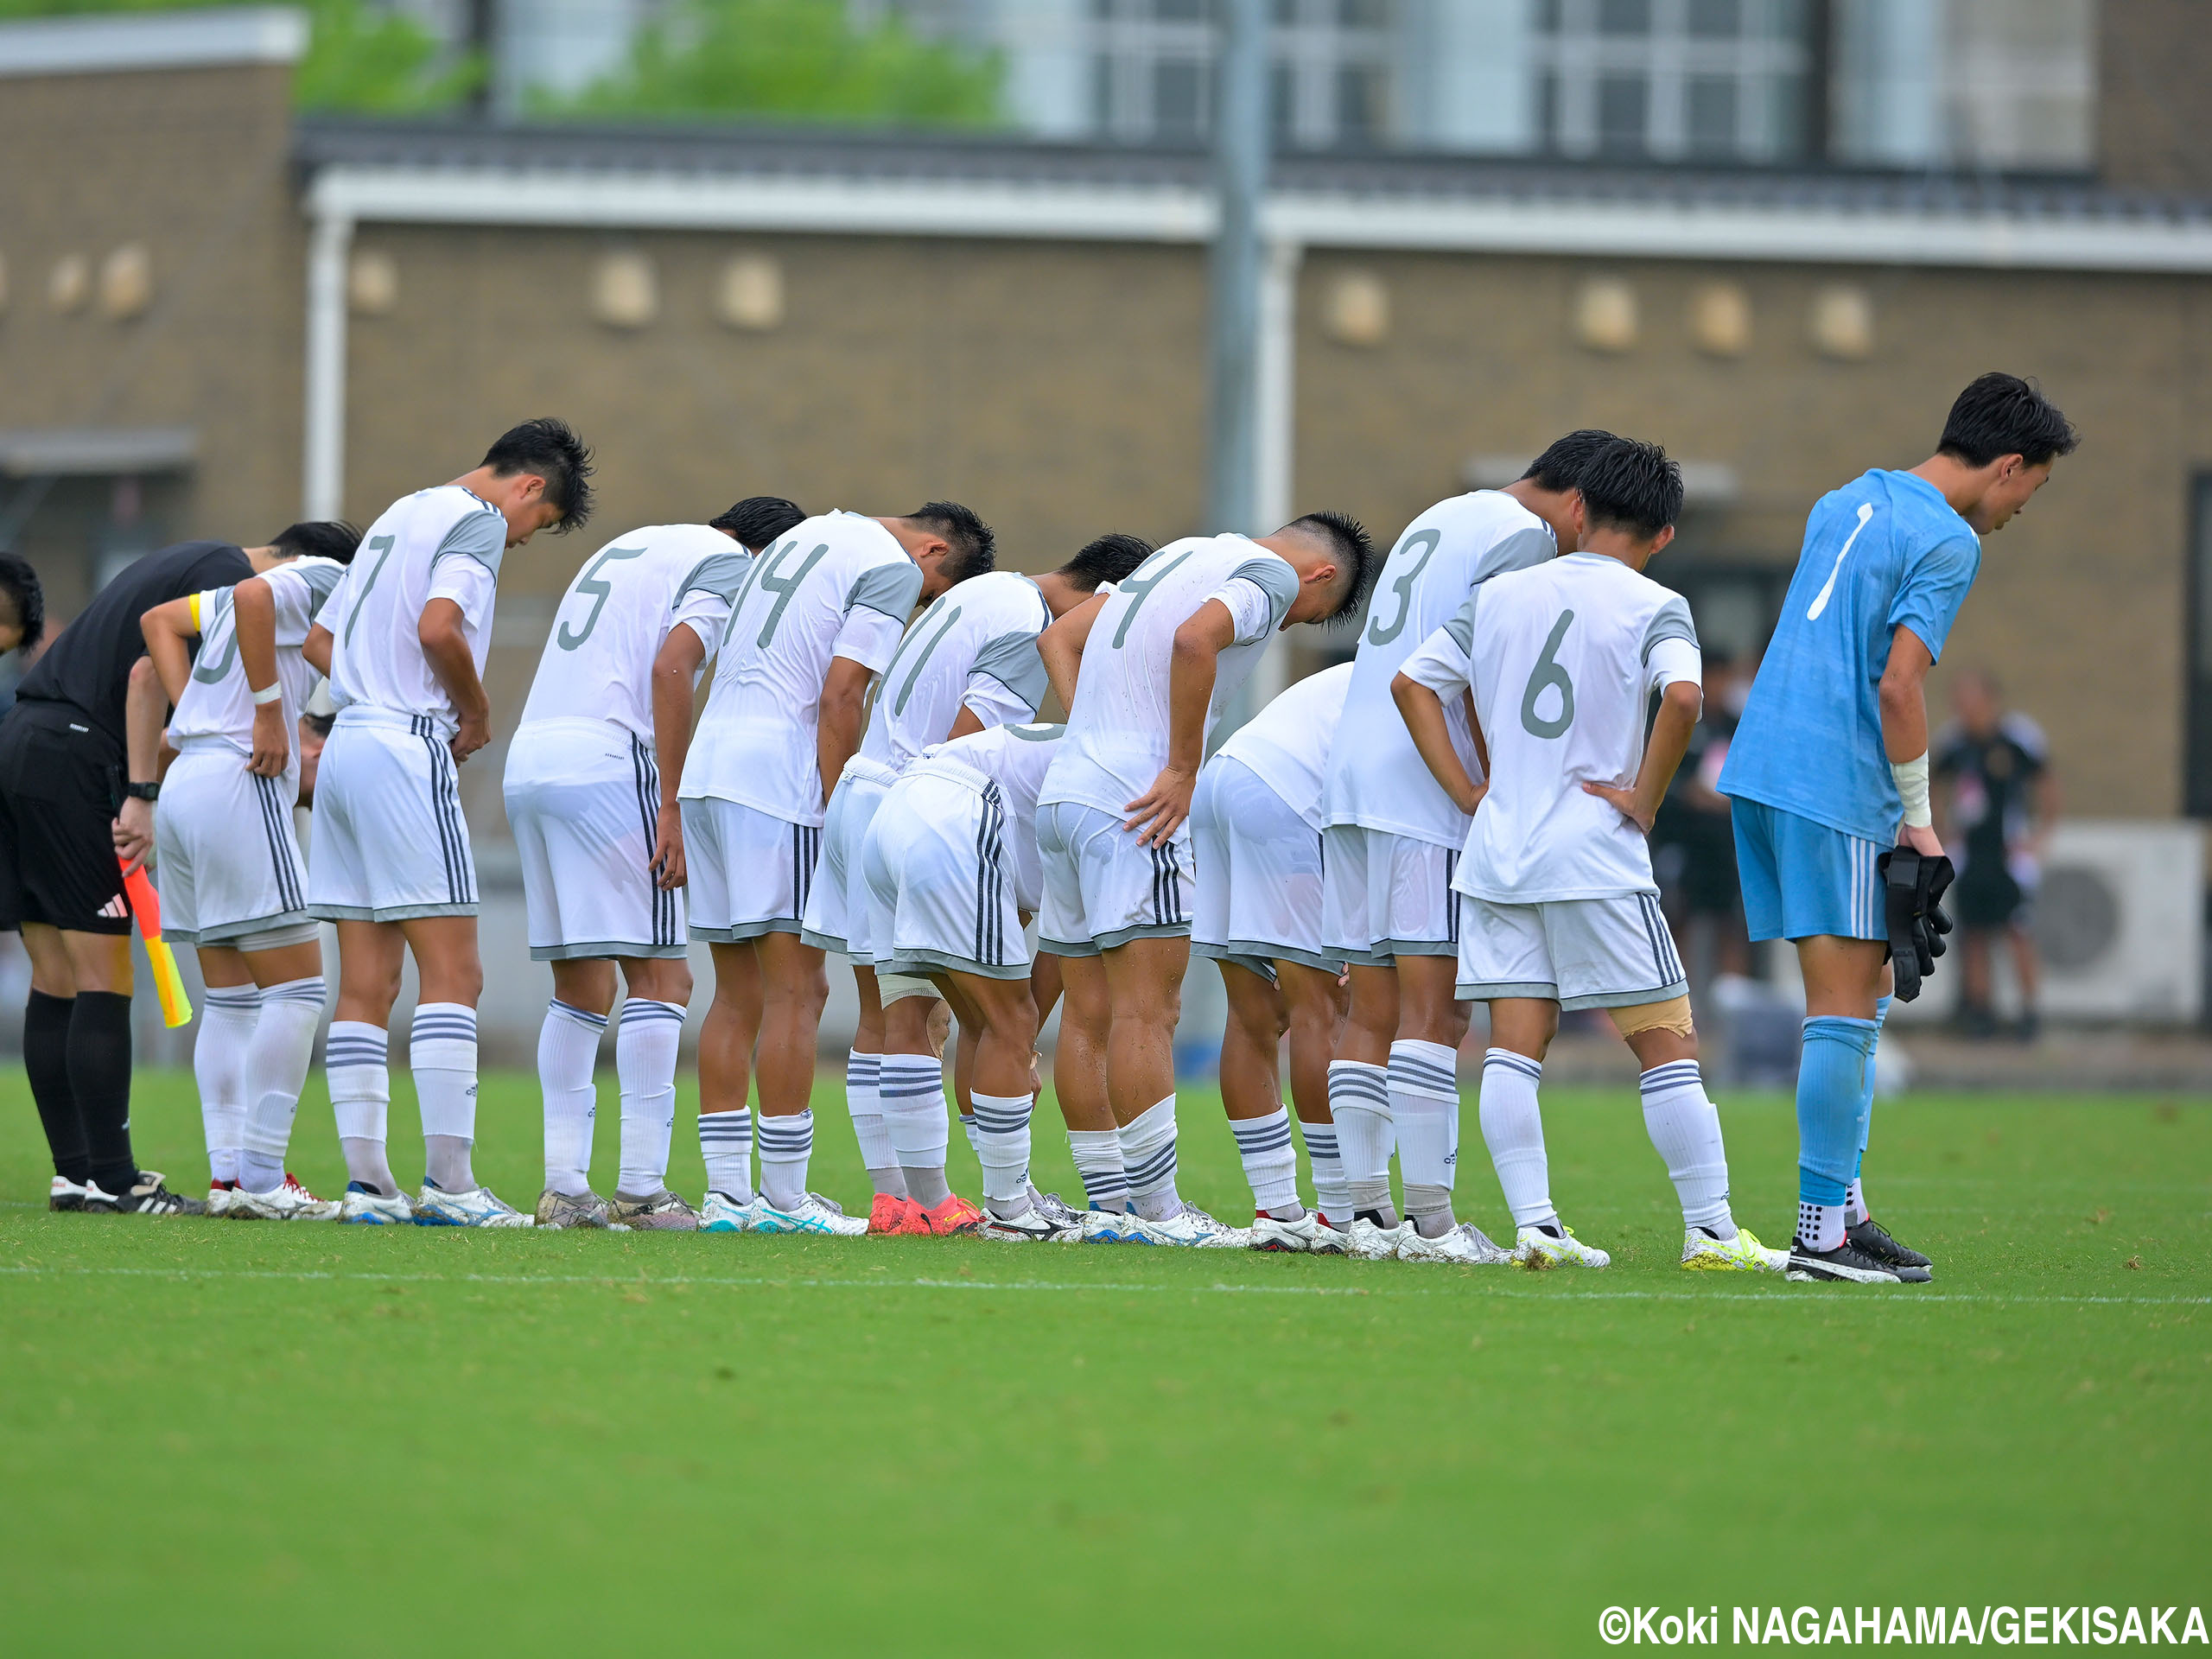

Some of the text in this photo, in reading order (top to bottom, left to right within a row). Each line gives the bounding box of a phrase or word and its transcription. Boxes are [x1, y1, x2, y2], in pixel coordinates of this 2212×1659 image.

[344, 535, 395, 651] 7
[557, 546, 647, 651] 5
[722, 540, 829, 649] 14
[1113, 550, 1193, 650] 4
[1369, 529, 1440, 646] 3
[1808, 503, 1873, 620] 1
[874, 595, 961, 717] 11
[1521, 609, 1574, 739] 6
